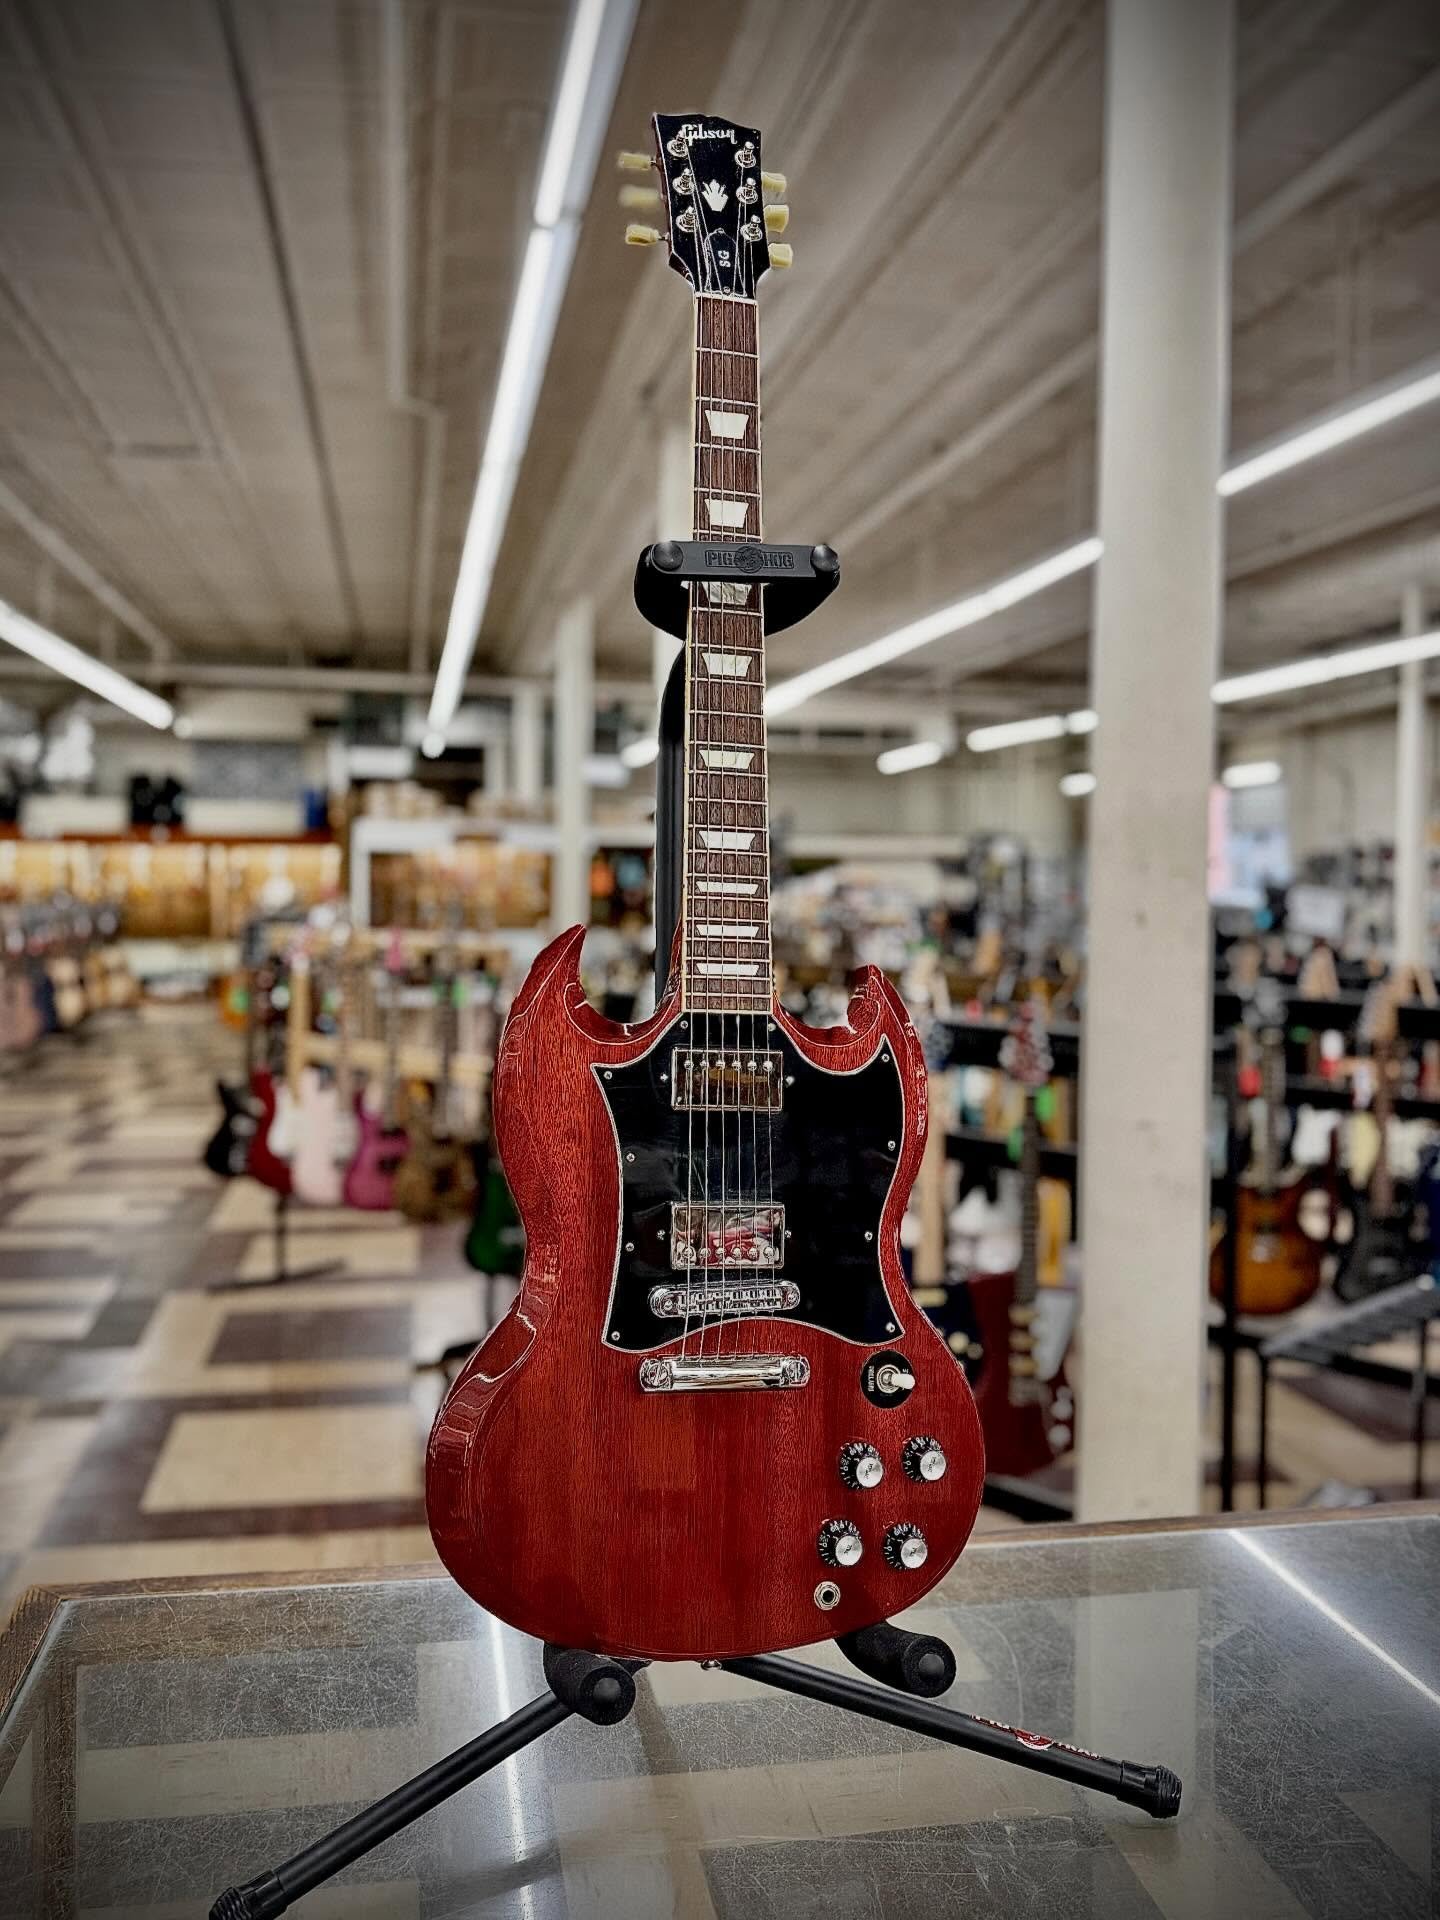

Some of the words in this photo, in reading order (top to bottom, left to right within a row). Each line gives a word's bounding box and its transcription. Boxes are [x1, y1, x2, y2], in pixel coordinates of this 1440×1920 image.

[681, 123, 738, 146] Gibson
[718, 250, 731, 268] SG
[706, 551, 737, 566] PIG
[763, 553, 793, 568] HOG
